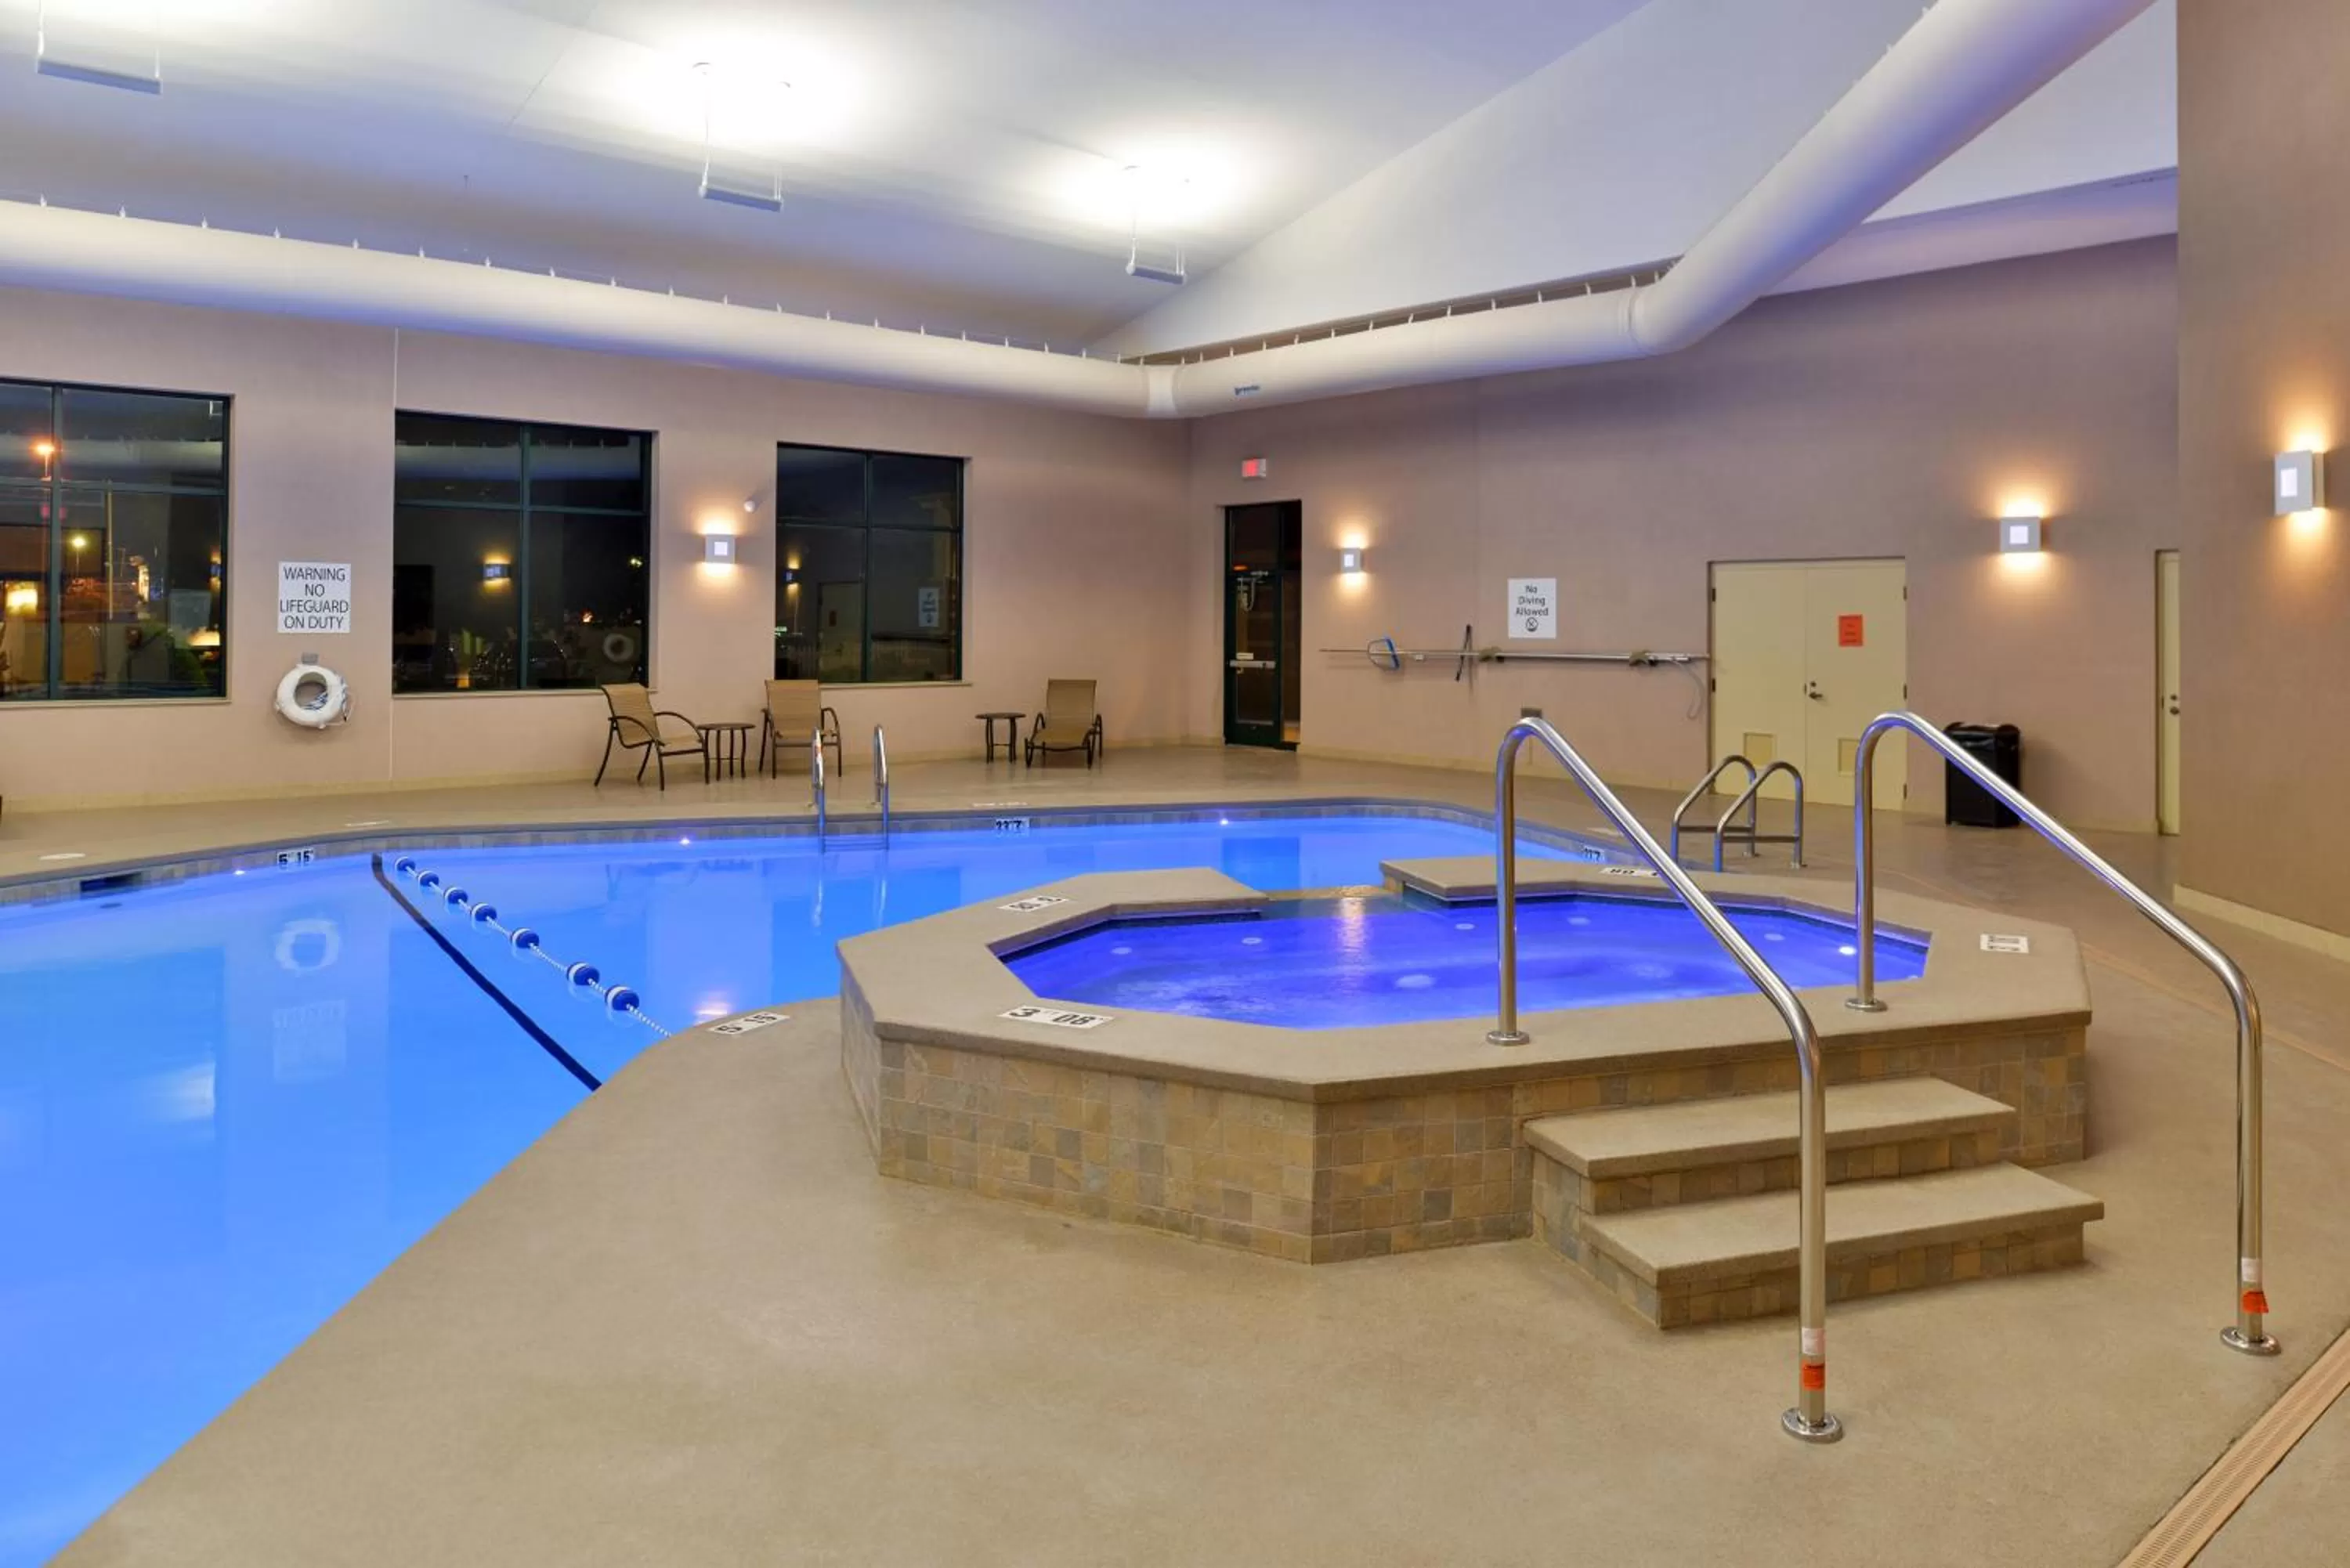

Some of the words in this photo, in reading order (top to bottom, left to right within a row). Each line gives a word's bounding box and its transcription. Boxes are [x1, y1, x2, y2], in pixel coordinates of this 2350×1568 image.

[283, 566, 345, 581] WARNING
[305, 583, 325, 597] NO
[1525, 584, 1538, 594] No
[280, 599, 349, 613] LIFEGUARD
[1517, 595, 1546, 607] Diving
[1516, 607, 1549, 616] Allowed
[284, 616, 305, 629] ON
[308, 616, 344, 629] DUTY
